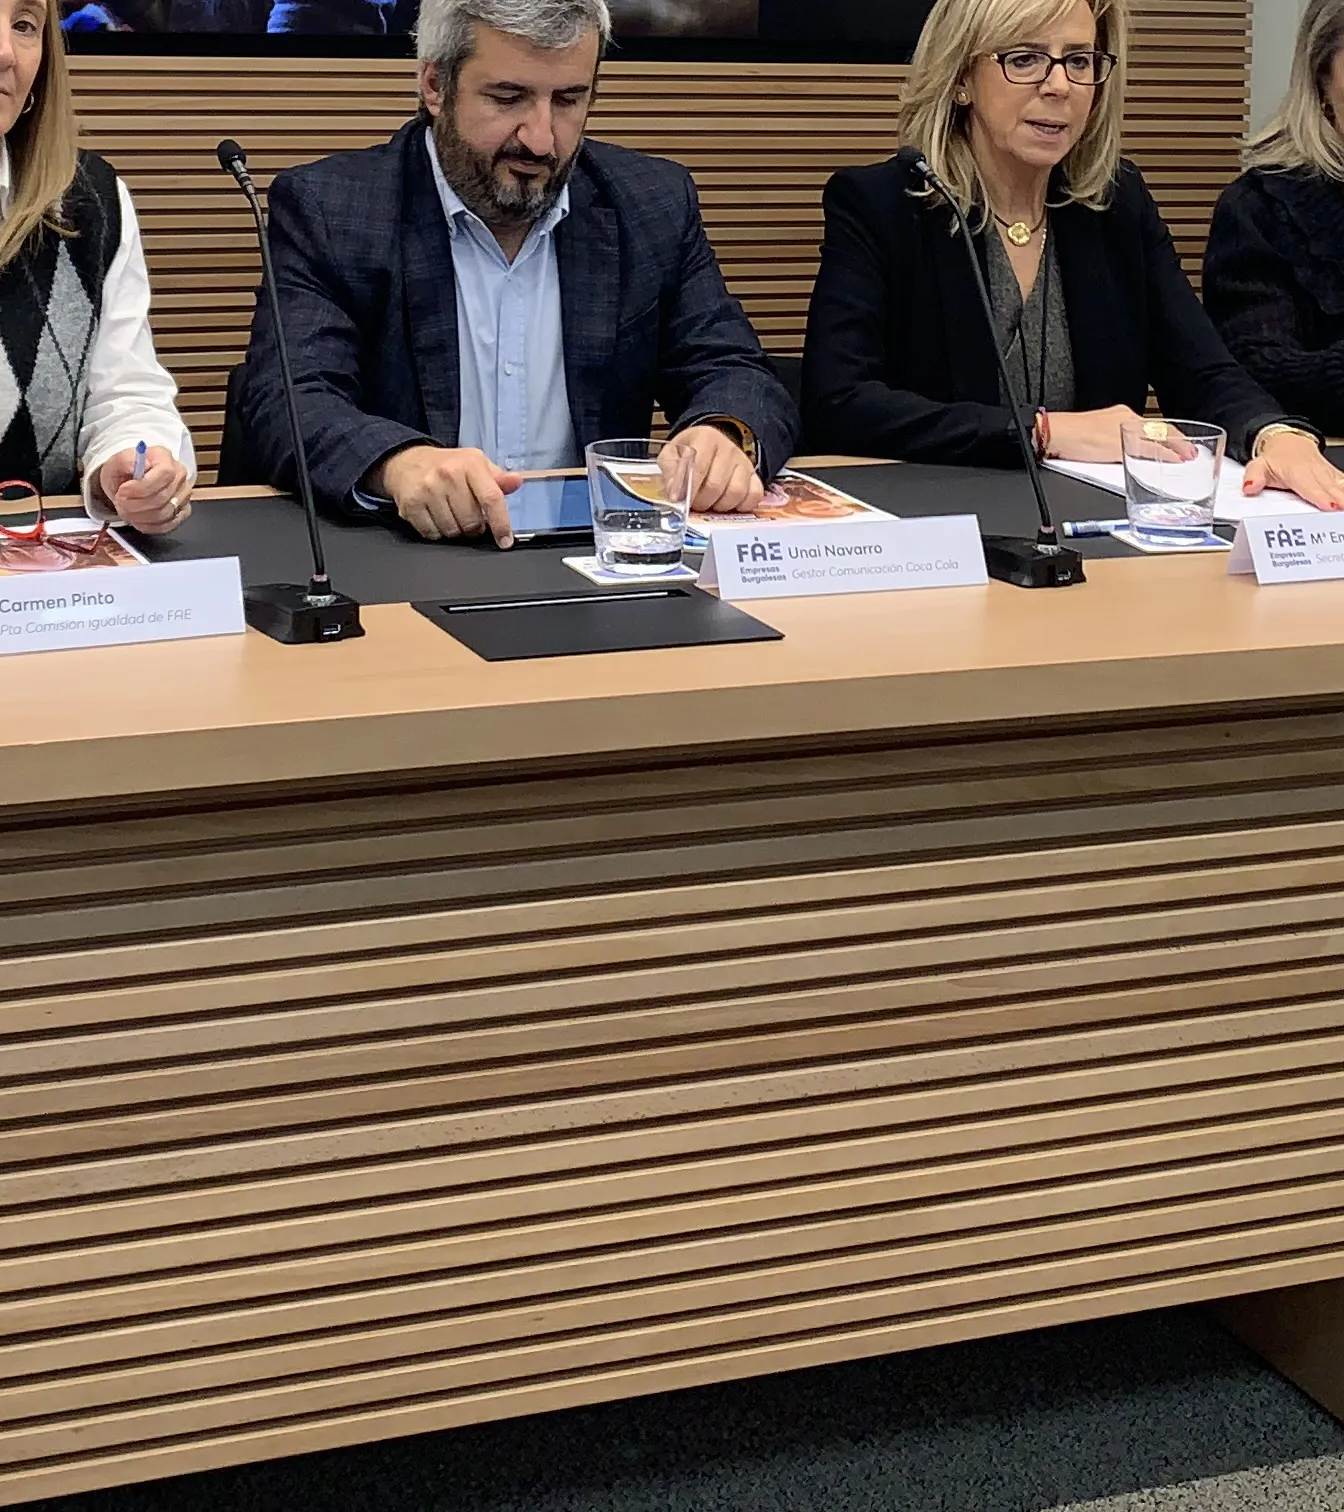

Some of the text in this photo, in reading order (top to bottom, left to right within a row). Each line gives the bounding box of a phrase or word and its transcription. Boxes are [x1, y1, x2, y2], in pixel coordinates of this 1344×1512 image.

[788, 544, 883, 559] Unai Navarro
[1270, 551, 1305, 560] Empresas
[792, 559, 959, 579] Gestor Comunicación Coca Cola
[1272, 559, 1312, 569] Burgalesas
[740, 566, 780, 576] Empresas
[741, 574, 787, 584] Burgalesas
[71, 591, 115, 606] Pinto
[0, 624, 22, 636] Pta
[88, 612, 145, 631] igualdad
[147, 612, 164, 624] de
[167, 608, 192, 621] FAE
